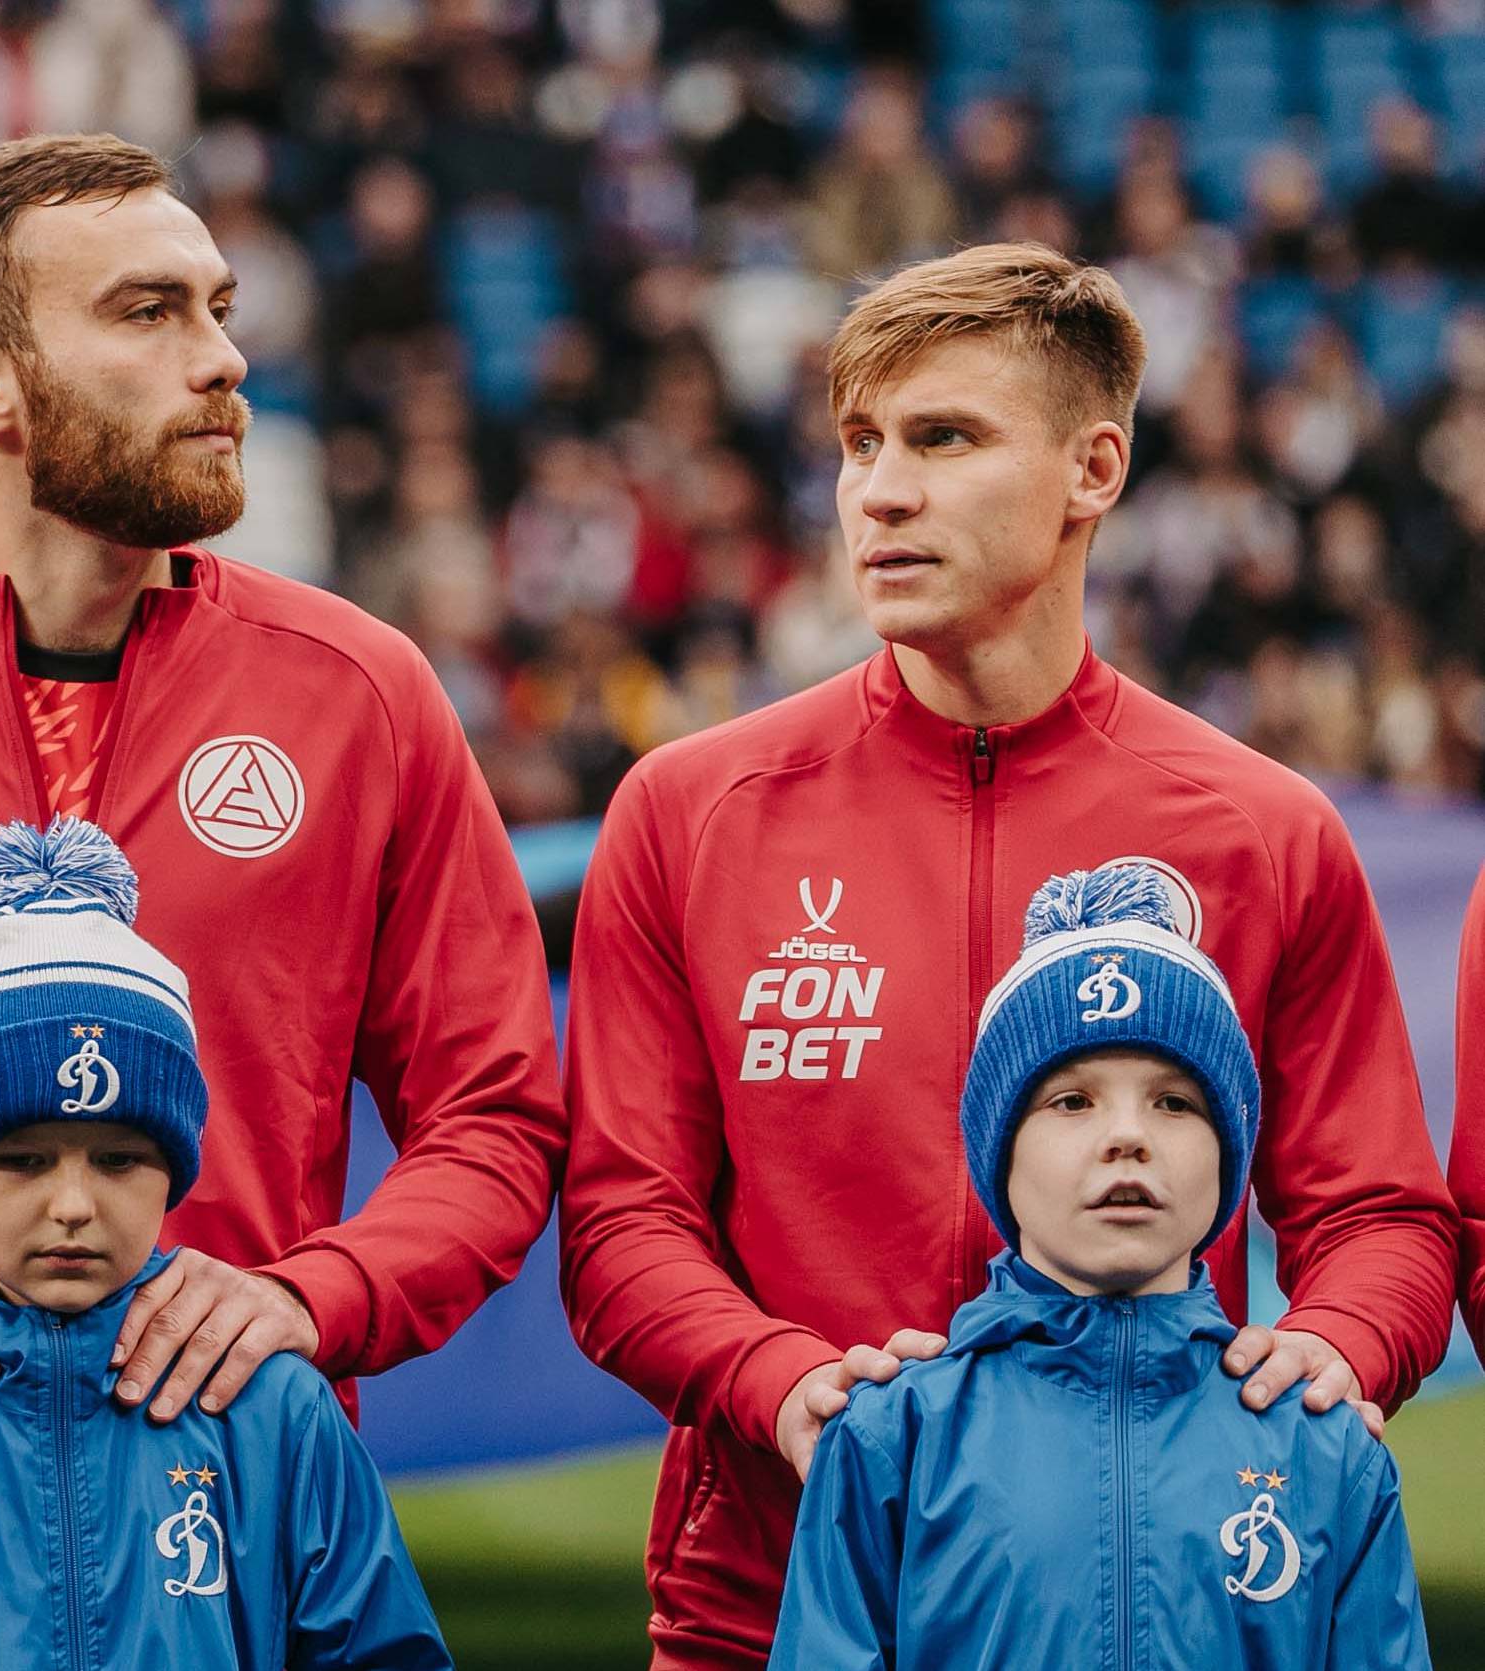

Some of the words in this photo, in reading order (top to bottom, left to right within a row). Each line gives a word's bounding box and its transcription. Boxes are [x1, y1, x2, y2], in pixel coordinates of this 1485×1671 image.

[768, 936, 867, 962] JÖGEL
[739, 966, 885, 1021] FON
[739, 1027, 883, 1081] BET
